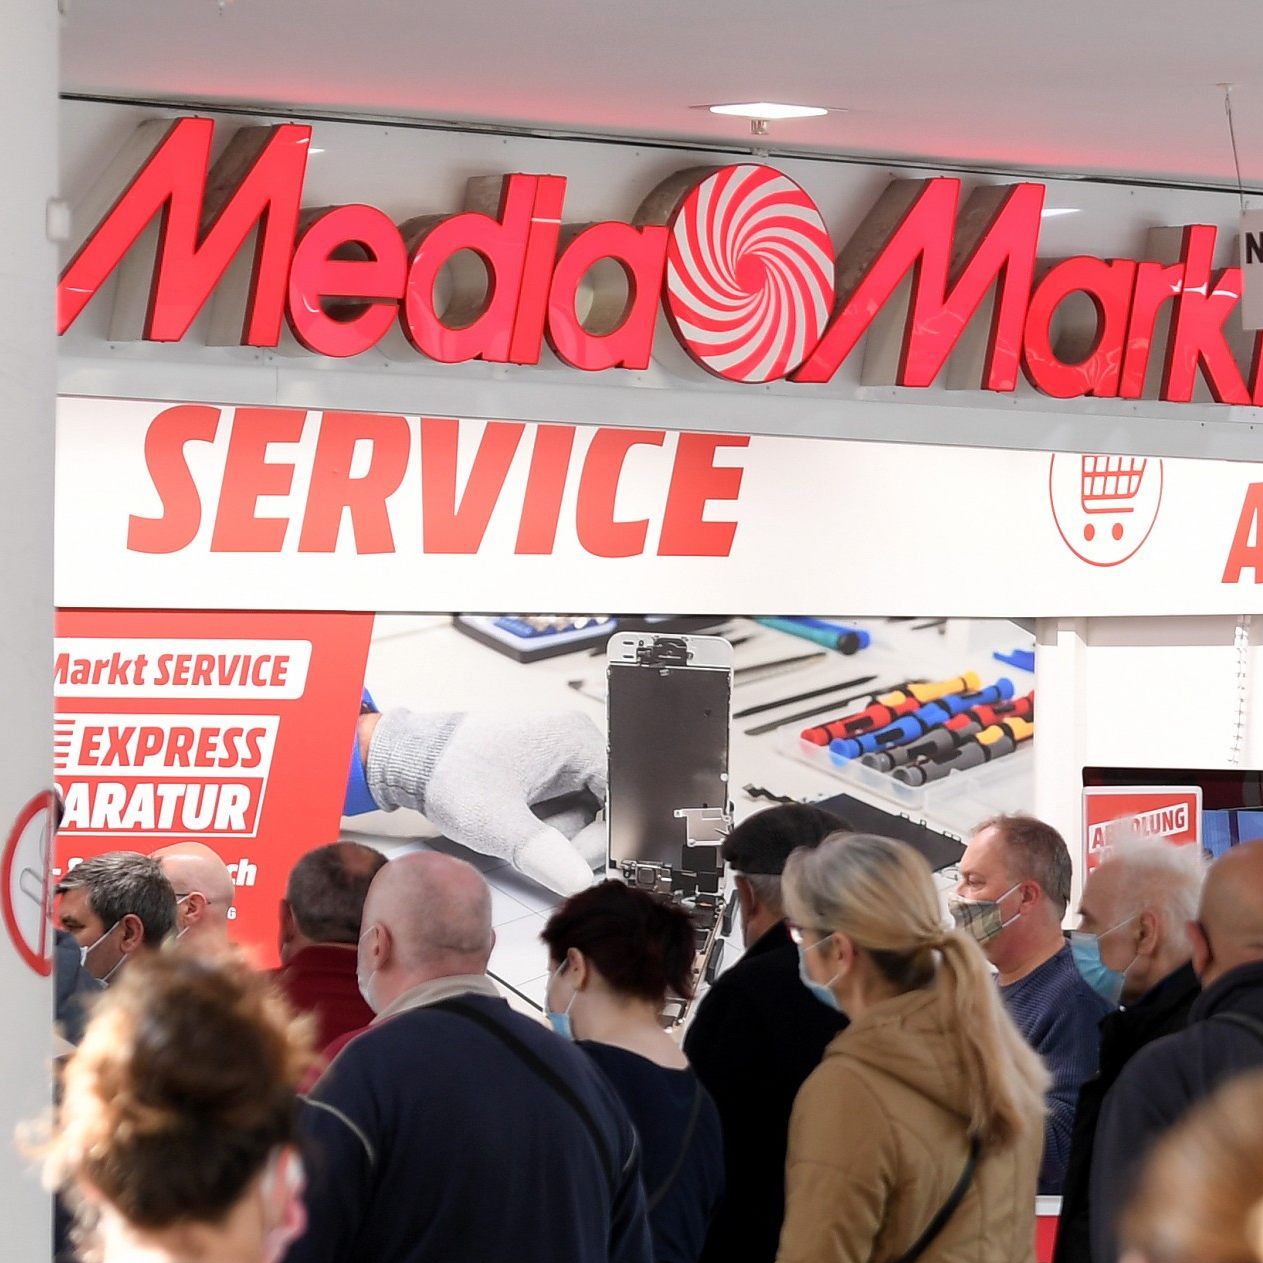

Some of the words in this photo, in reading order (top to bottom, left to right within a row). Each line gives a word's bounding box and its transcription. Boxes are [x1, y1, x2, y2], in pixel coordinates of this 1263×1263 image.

[57, 117, 668, 371] Media
[127, 405, 750, 558] SERVICE
[153, 653, 290, 687] SERVICE
[77, 726, 267, 769] EXPRESS
